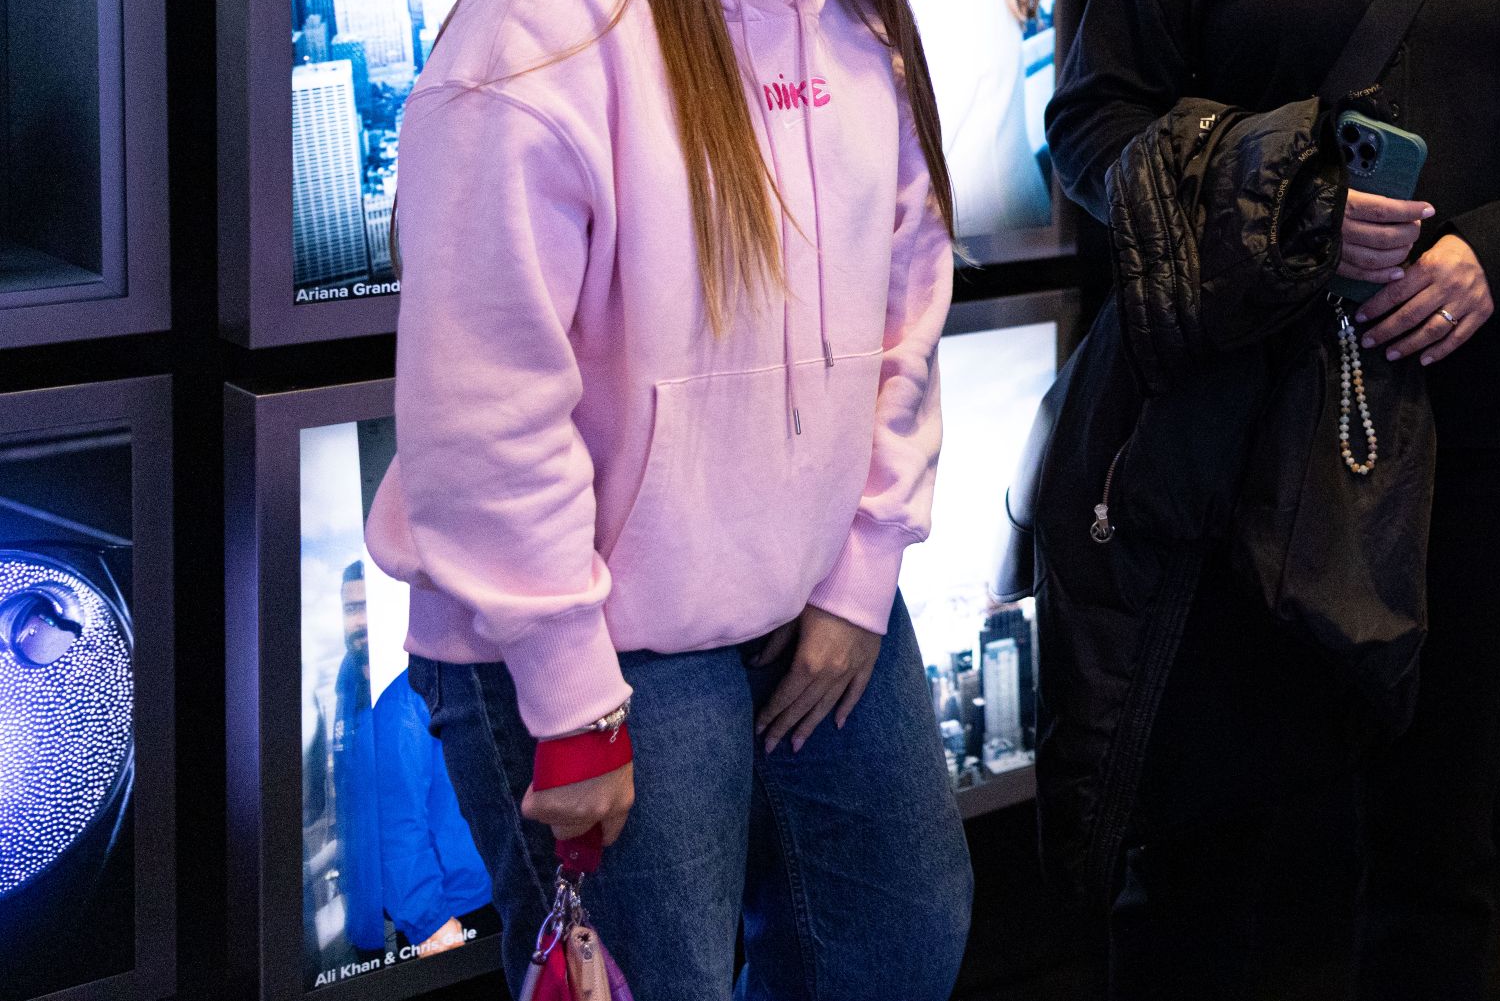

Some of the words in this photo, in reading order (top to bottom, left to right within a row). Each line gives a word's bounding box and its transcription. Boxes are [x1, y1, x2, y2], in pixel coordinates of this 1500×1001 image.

[296, 286, 349, 302] Ariana
[352, 280, 401, 296] Grand
[314, 970, 336, 988] Ali
[340, 957, 381, 980] Khan
[384, 952, 396, 966] &
[399, 939, 440, 960] Chris
